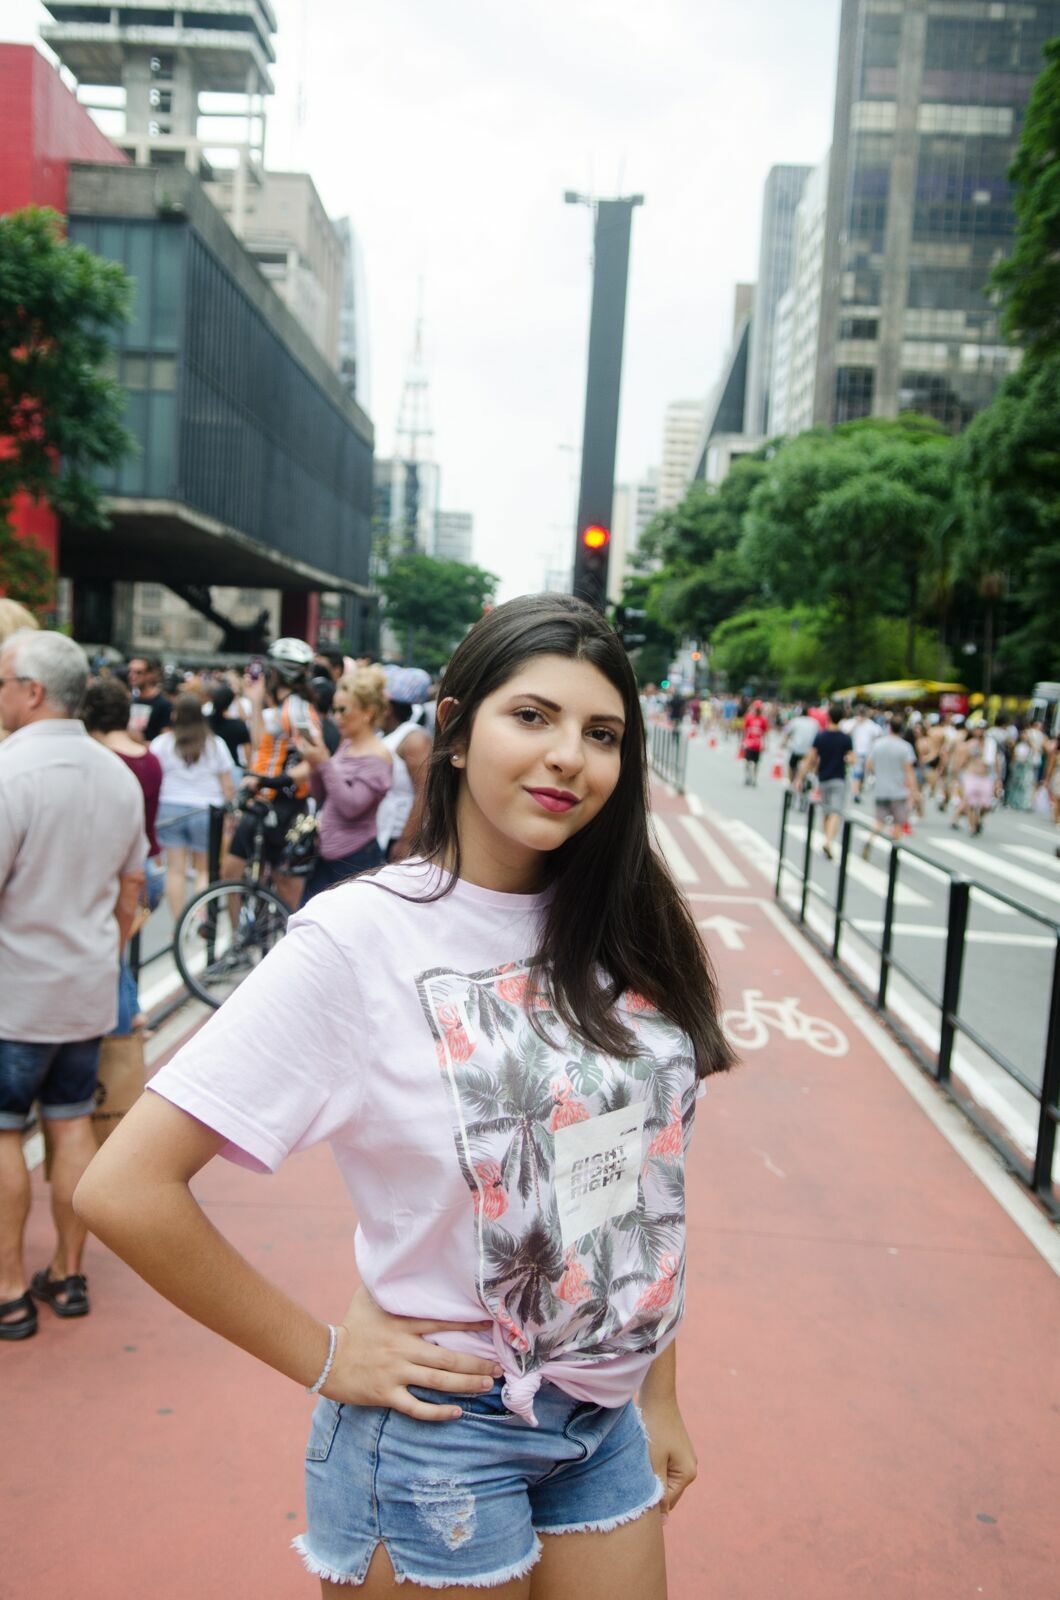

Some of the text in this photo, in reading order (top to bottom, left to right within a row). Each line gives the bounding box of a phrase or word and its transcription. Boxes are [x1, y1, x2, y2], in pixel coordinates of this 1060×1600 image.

[571, 1145, 626, 1173] RIGHT
[571, 1157, 627, 1186] RIGHT
[570, 1170, 625, 1200] RIGHT
